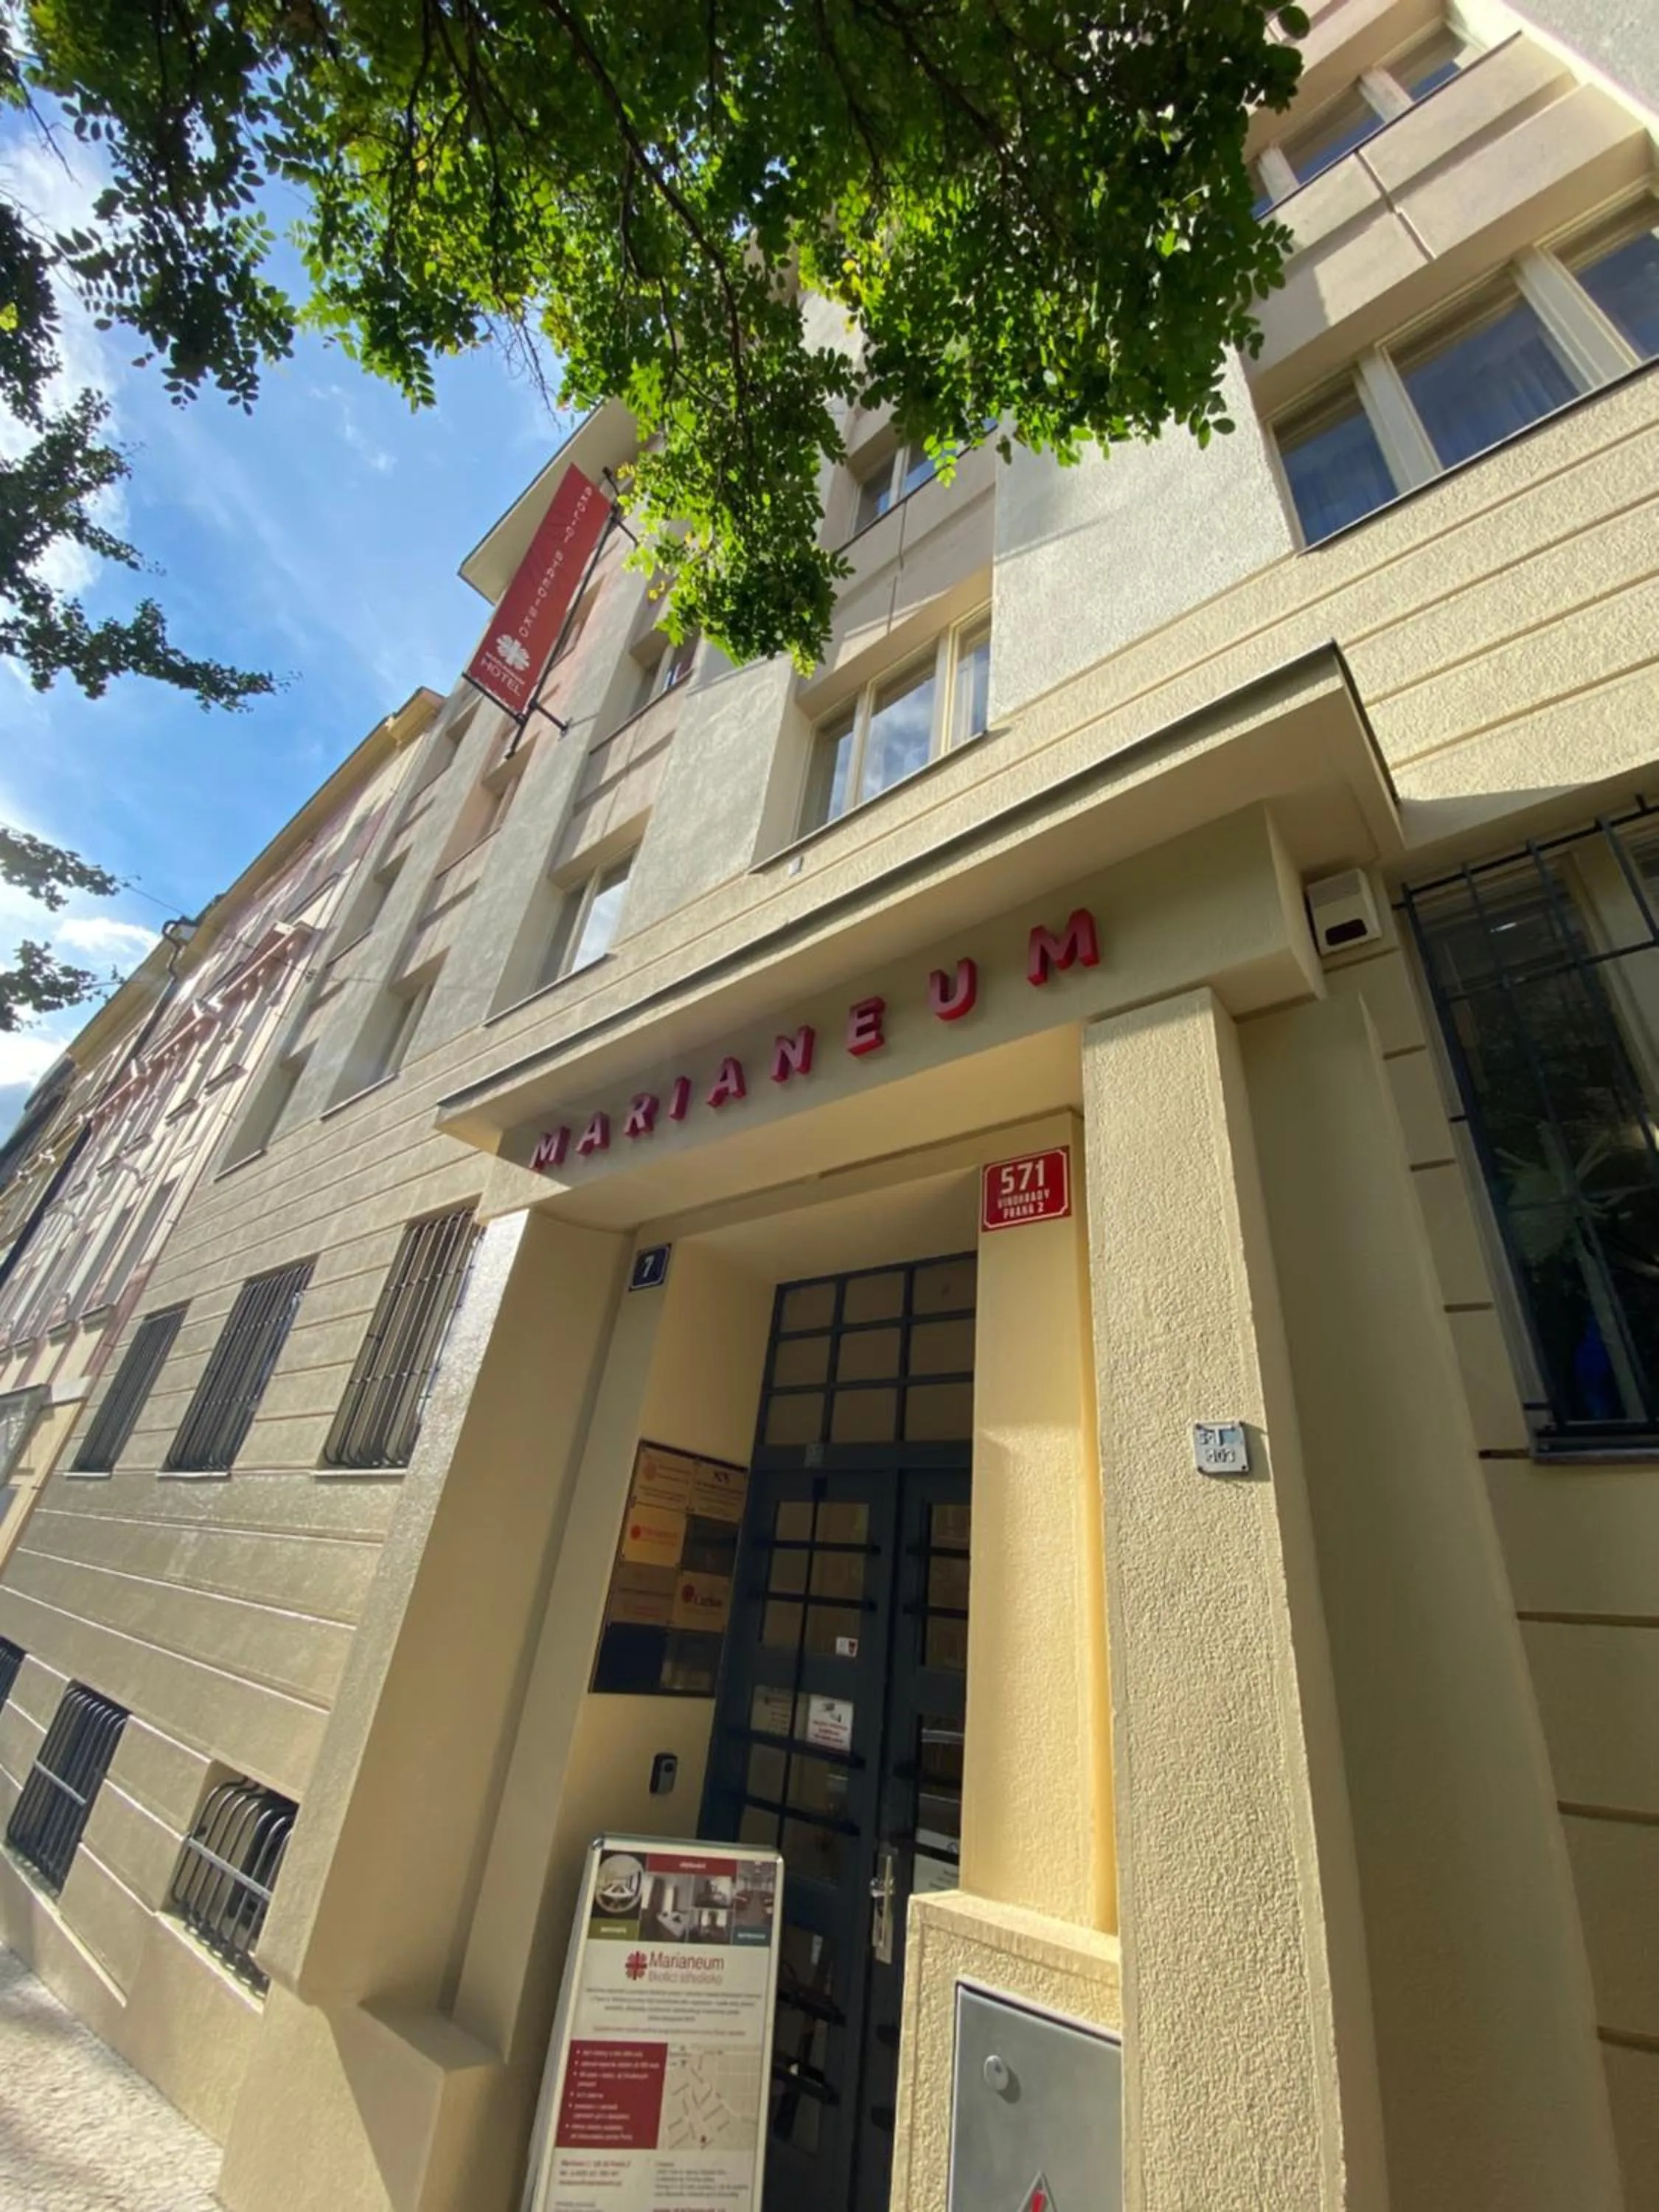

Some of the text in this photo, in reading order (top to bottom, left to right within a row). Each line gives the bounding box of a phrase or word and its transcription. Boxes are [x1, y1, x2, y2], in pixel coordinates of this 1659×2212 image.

[481, 657, 521, 697] HOTEL
[528, 907, 1101, 1173] MARIANEUM
[1001, 1158, 1045, 1194] 571
[1003, 1201, 1045, 1220] PRAHA 2
[642, 1255, 655, 1278] 7
[649, 1950, 725, 1971] Marianeum
